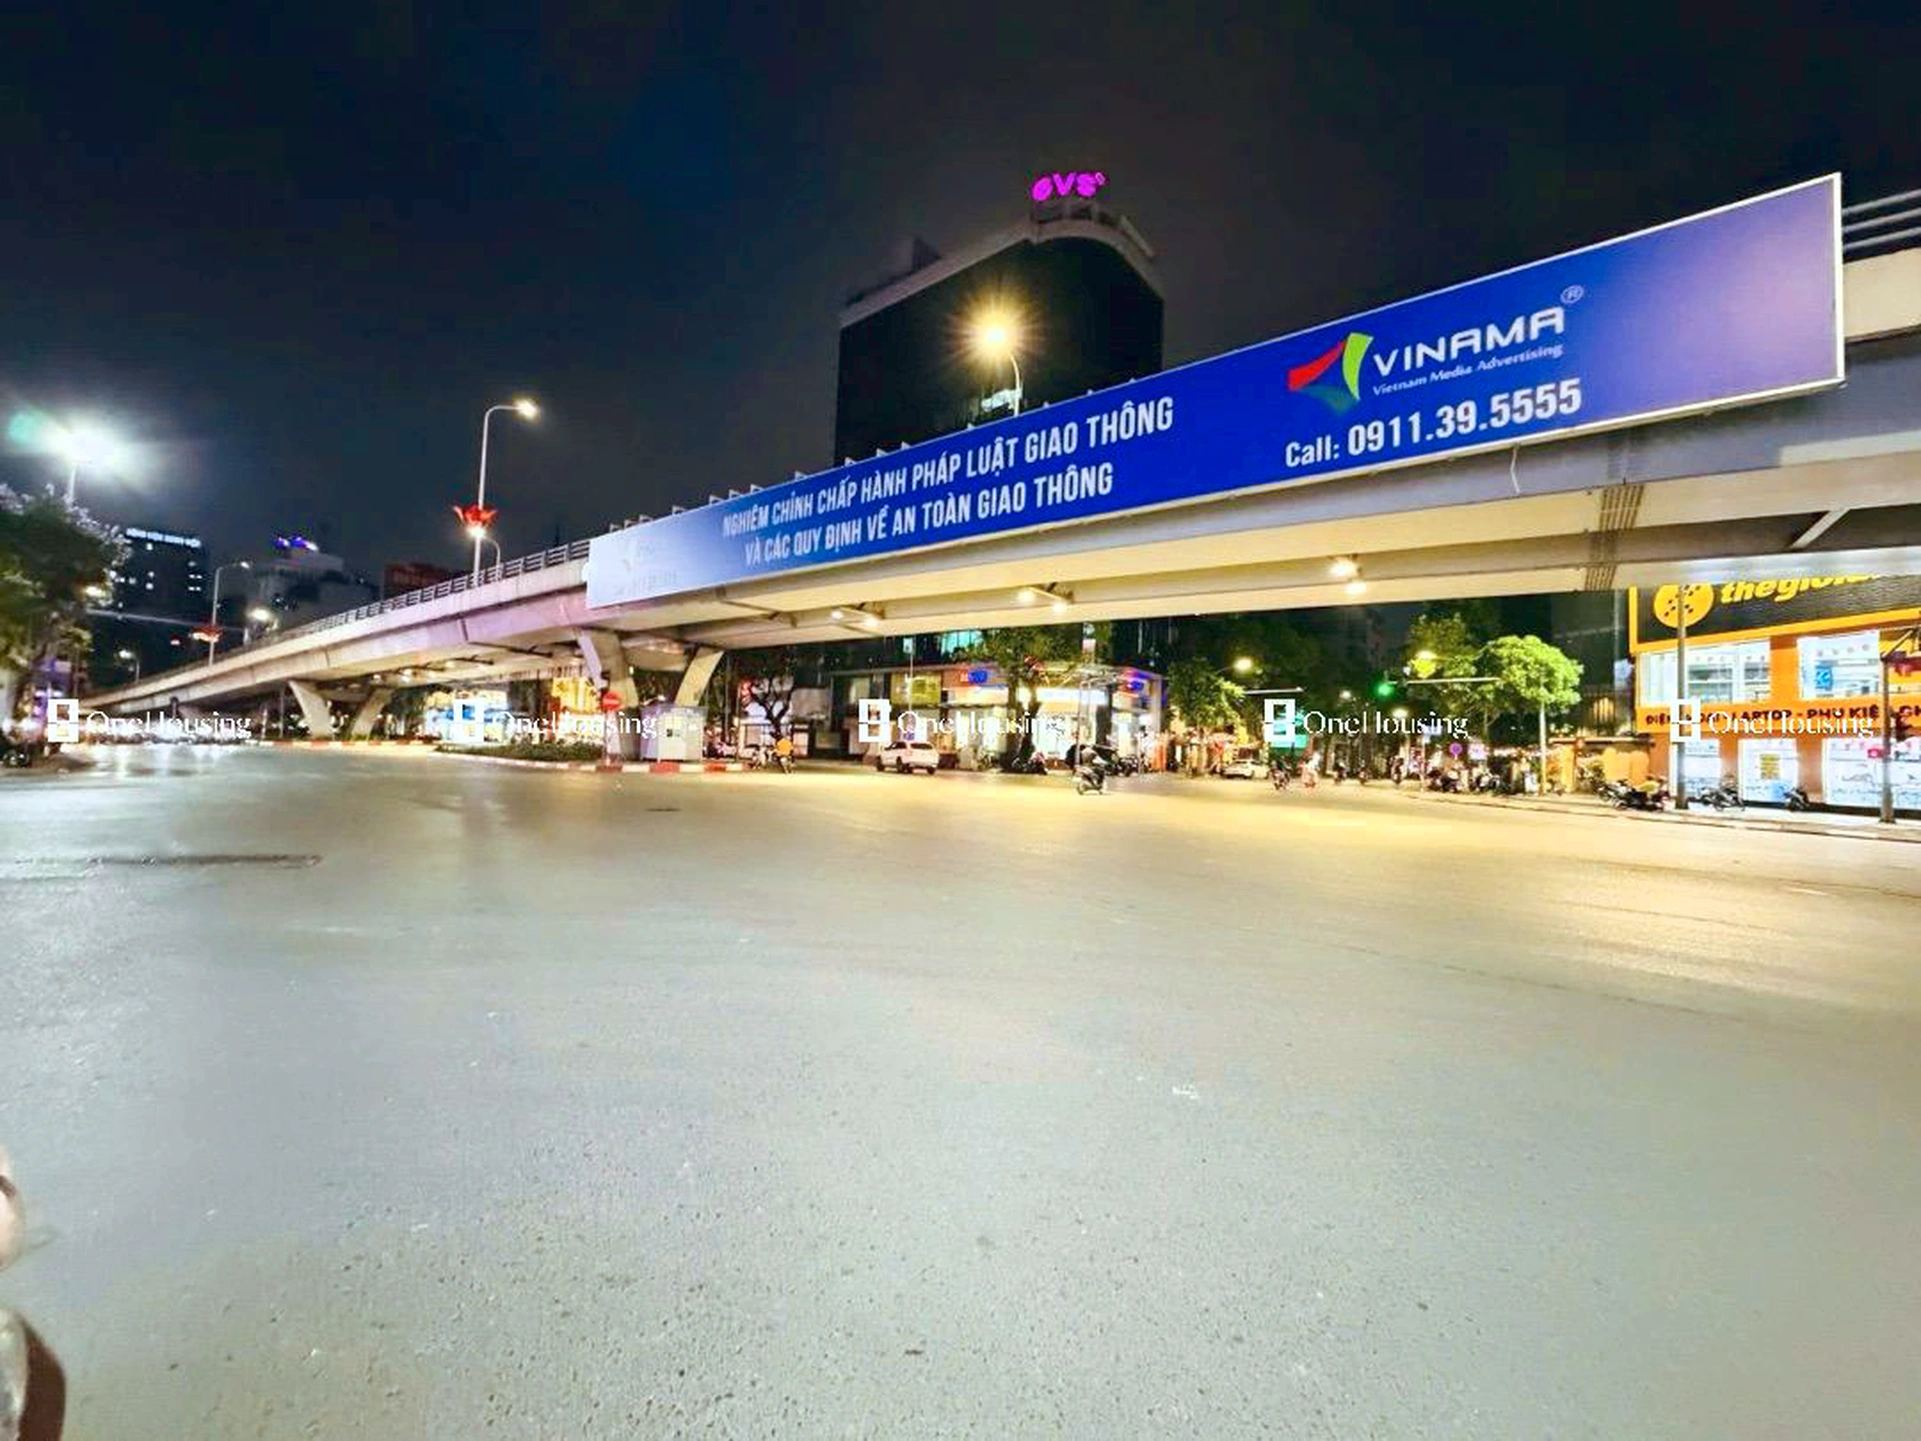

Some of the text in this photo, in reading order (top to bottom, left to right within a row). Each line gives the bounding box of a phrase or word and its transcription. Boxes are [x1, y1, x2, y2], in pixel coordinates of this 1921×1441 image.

[1372, 343, 1564, 397] Vietnam Media Advertising
[1373, 305, 1565, 377] VINAMA
[722, 503, 769, 538] NGHIÊM
[817, 474, 858, 515] CHẤP
[861, 470, 907, 504] HÀNH
[912, 450, 961, 492] PHÁP
[966, 436, 1019, 478] LUẬT
[1025, 421, 1079, 464] GIAO
[1086, 396, 1174, 449] THÔNG
[1285, 377, 1582, 469] Call: 0911.39.5555
[745, 461, 1114, 566] VÀ CÁC QUY ĐỊNH VỀ AN TOÀN GIAO THÔNG
